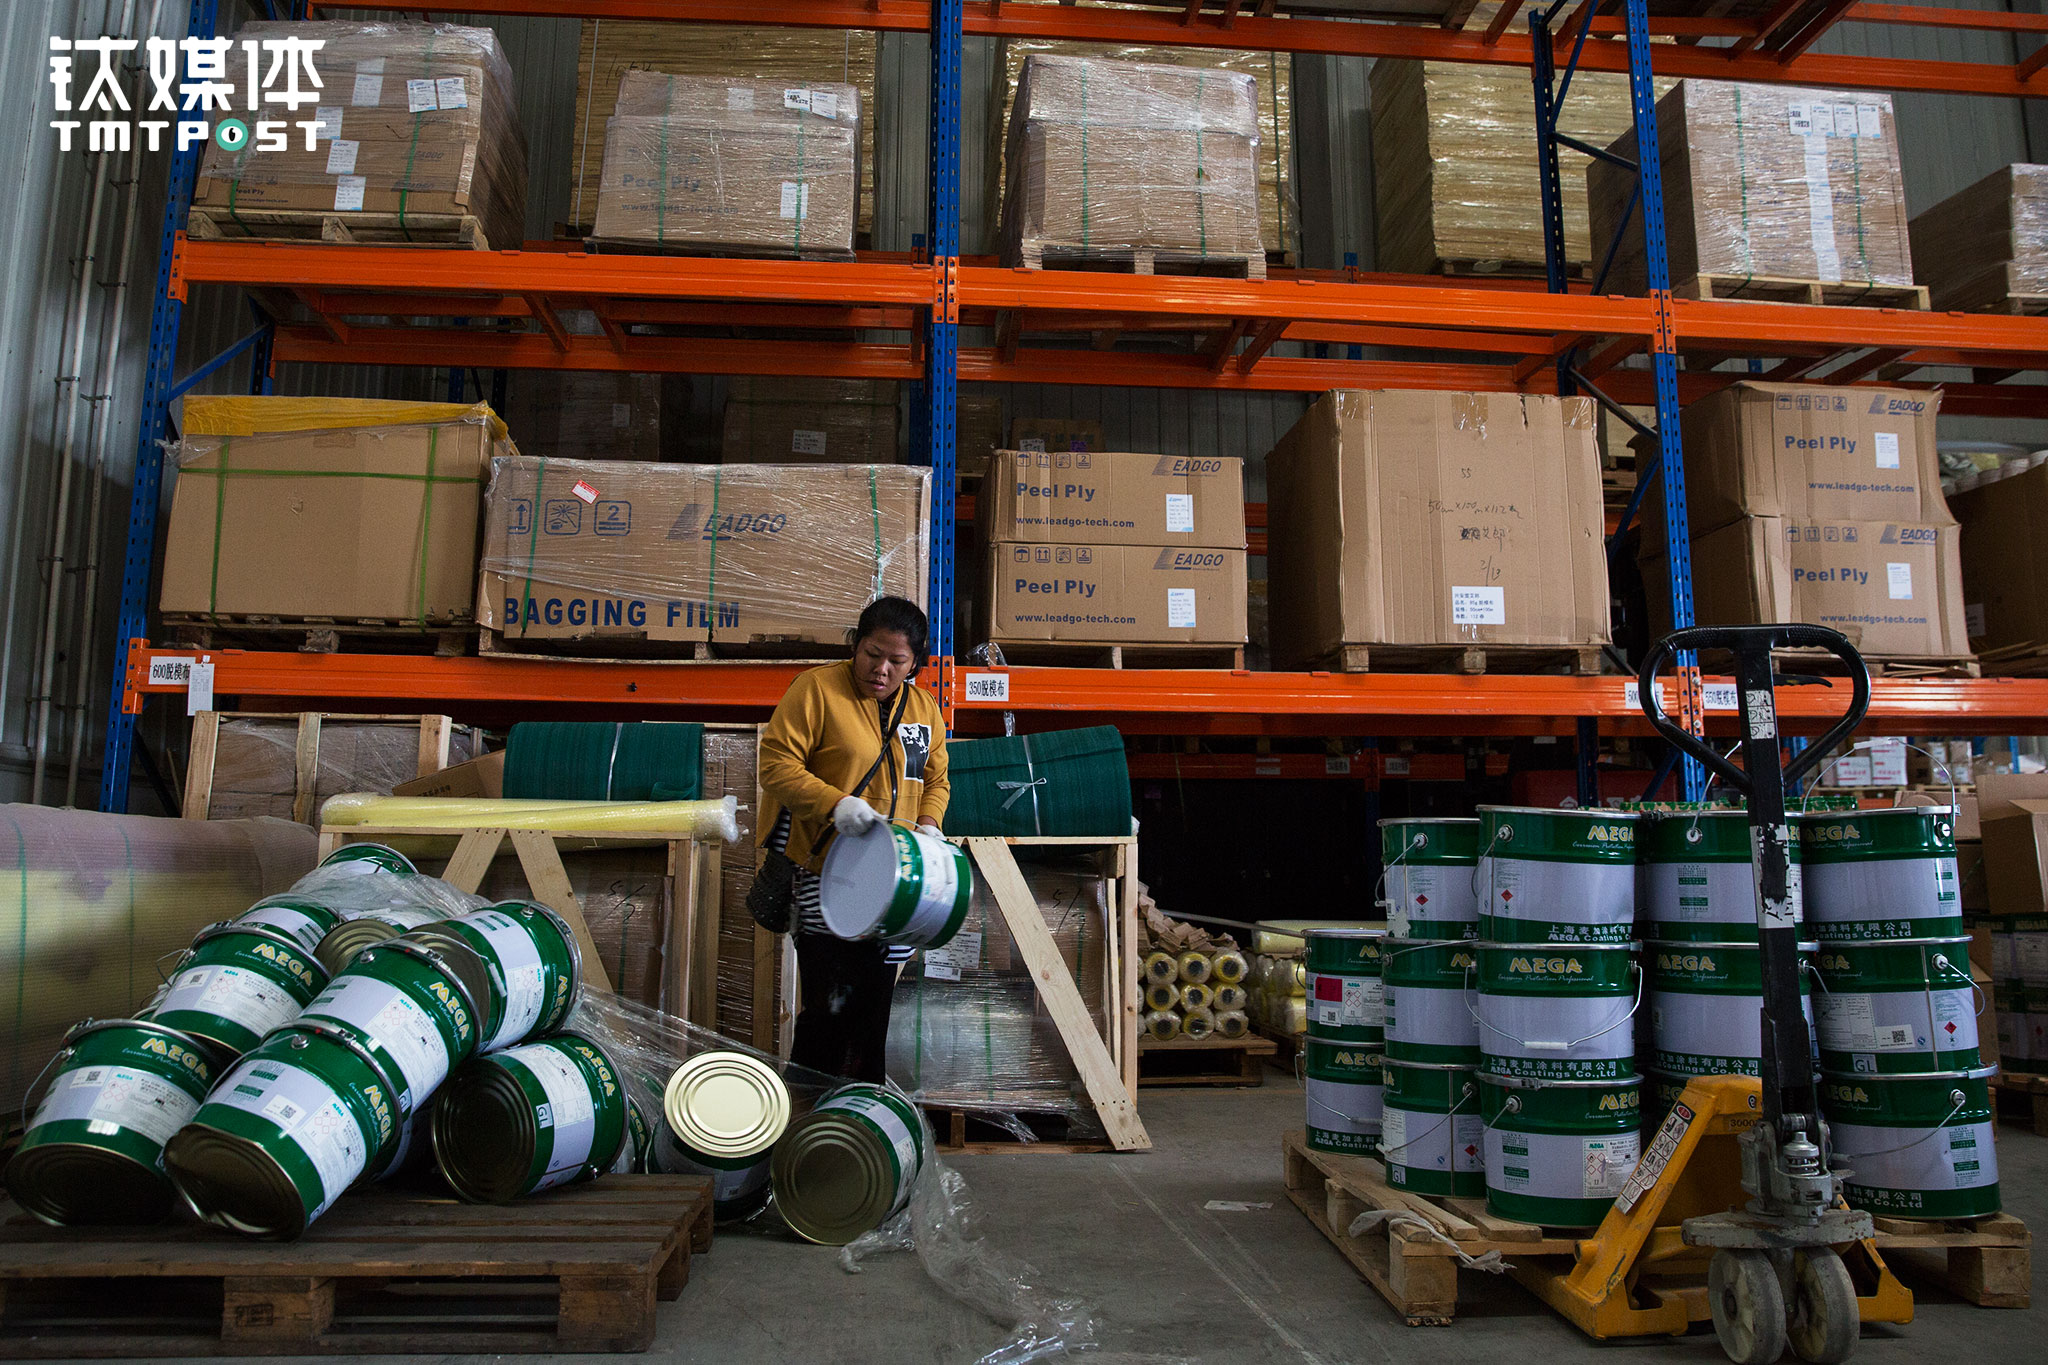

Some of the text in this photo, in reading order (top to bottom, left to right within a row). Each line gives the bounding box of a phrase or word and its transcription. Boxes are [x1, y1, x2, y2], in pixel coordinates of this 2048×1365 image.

[622, 174, 663, 188] Pee
[1785, 435, 1825, 450] Peel
[1830, 436, 1857, 453] Ply
[1016, 482, 1096, 501] Peel Ply
[1808, 482, 1915, 493] www.leadgo-tech.com
[1016, 515, 1135, 529] www.leadgo-tech.com
[1794, 567, 1835, 582] Peel
[1840, 568, 1869, 585] Ply
[1015, 578, 1096, 598] Peel Ply
[504, 597, 739, 628] BAGGING FILM
[1015, 613, 1136, 626] www.leadgo-tech.com
[1820, 614, 1927, 625] www.leadgo-tech.com
[969, 680, 1004, 697] 350脱模布
[1548, 934, 1580, 942] MEGA
[252, 943, 313, 986] MEGA
[1509, 957, 1583, 974] MEGA
[1657, 953, 1716, 971] MEGA
[429, 981, 470, 1040] MEGA
[141, 1037, 209, 1080] MEGA
[1335, 1051, 1381, 1066] MEG
[1490, 1057, 1617, 1071] 上海麦加涂料有限公司
[1660, 1055, 1759, 1069] 麦加涂料有限公司
[1855, 1059, 1875, 1072] GL
[574, 1046, 616, 1097] MEGA
[1490, 1067, 1617, 1079] MEGA Coatings Co.,Ltd
[1829, 1085, 1869, 1103] EGA
[364, 1084, 392, 1145] MEGA
[537, 1105, 549, 1129] GL
[1315, 1131, 1376, 1144] 上海麦加涂料
[1336, 1141, 1375, 1150] Coating
[1393, 1170, 1405, 1184] GL
[1851, 1187, 1922, 1201] 料有限公司
